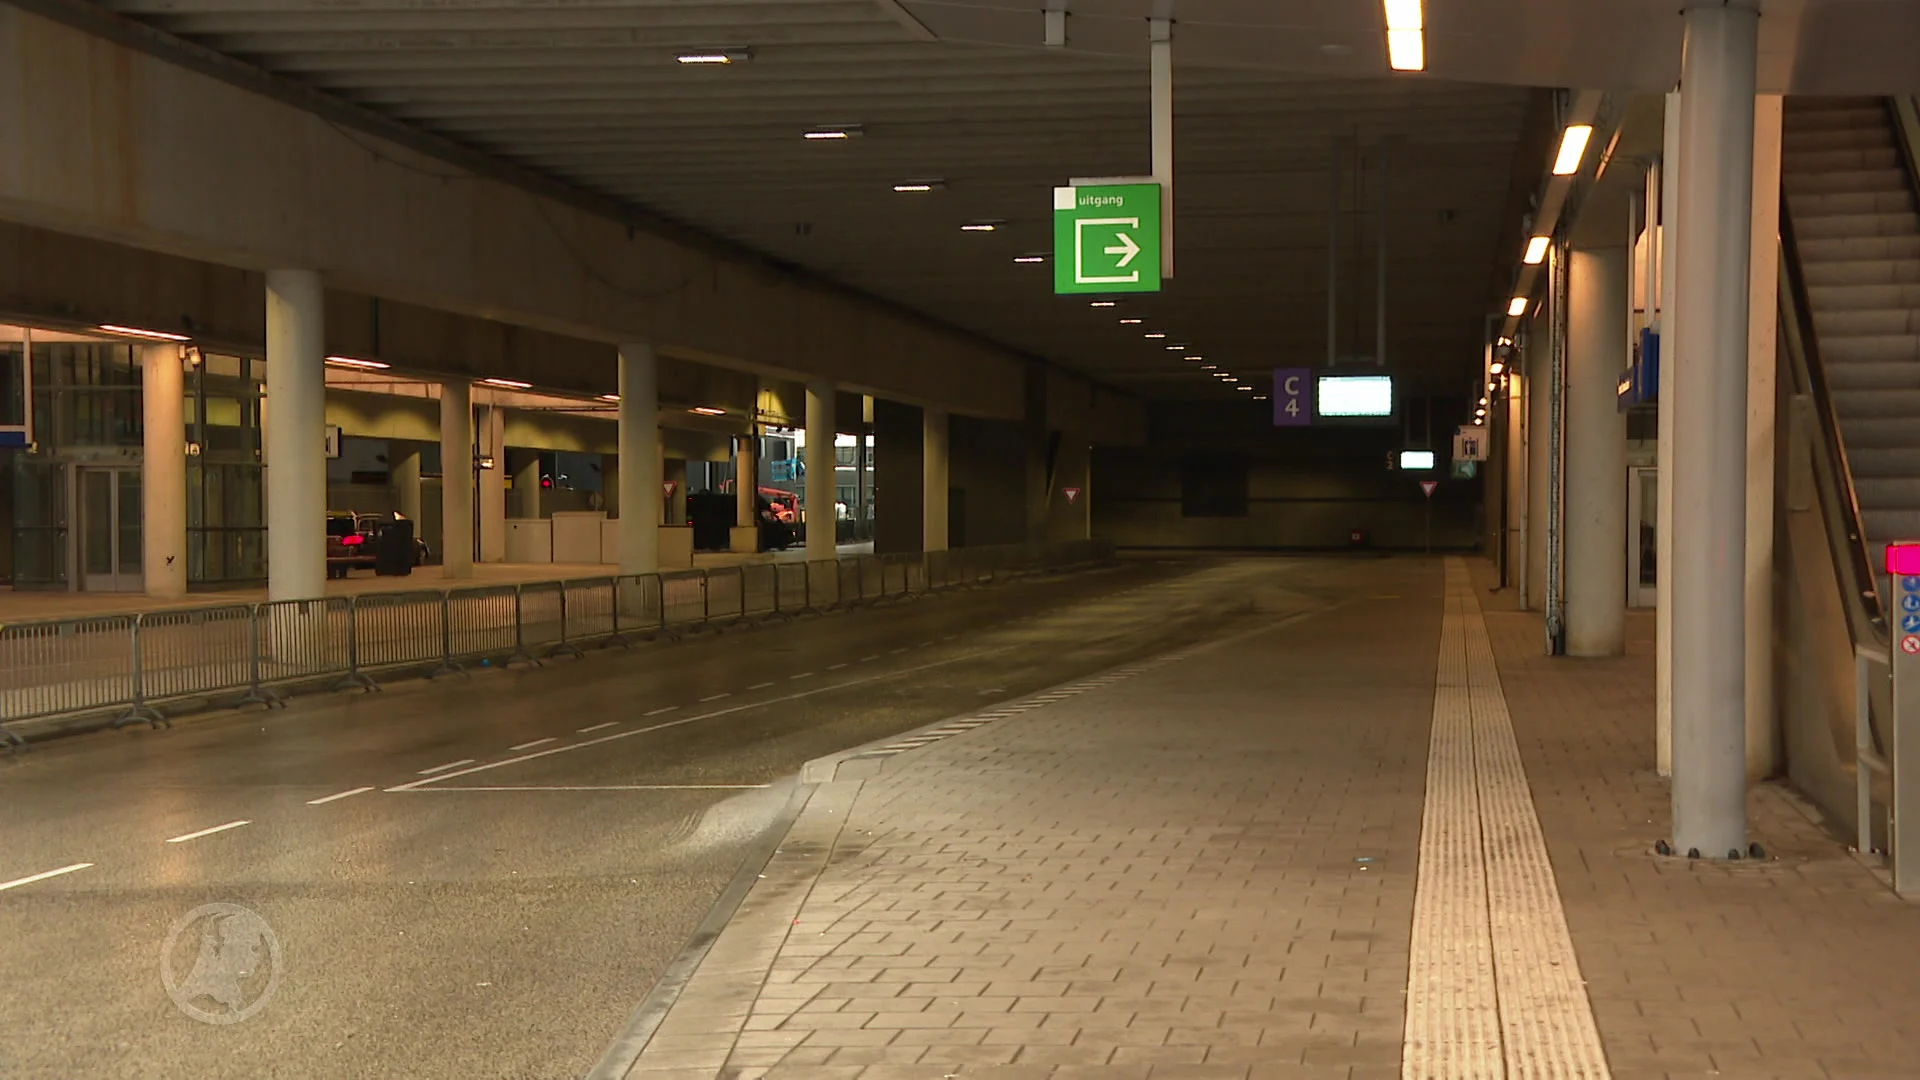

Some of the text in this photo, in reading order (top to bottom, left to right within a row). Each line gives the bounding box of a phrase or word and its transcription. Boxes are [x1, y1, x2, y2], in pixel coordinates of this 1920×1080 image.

[1079, 195, 1124, 208] uitgang
[1284, 376, 1300, 395] C
[1284, 398, 1300, 417] 4
